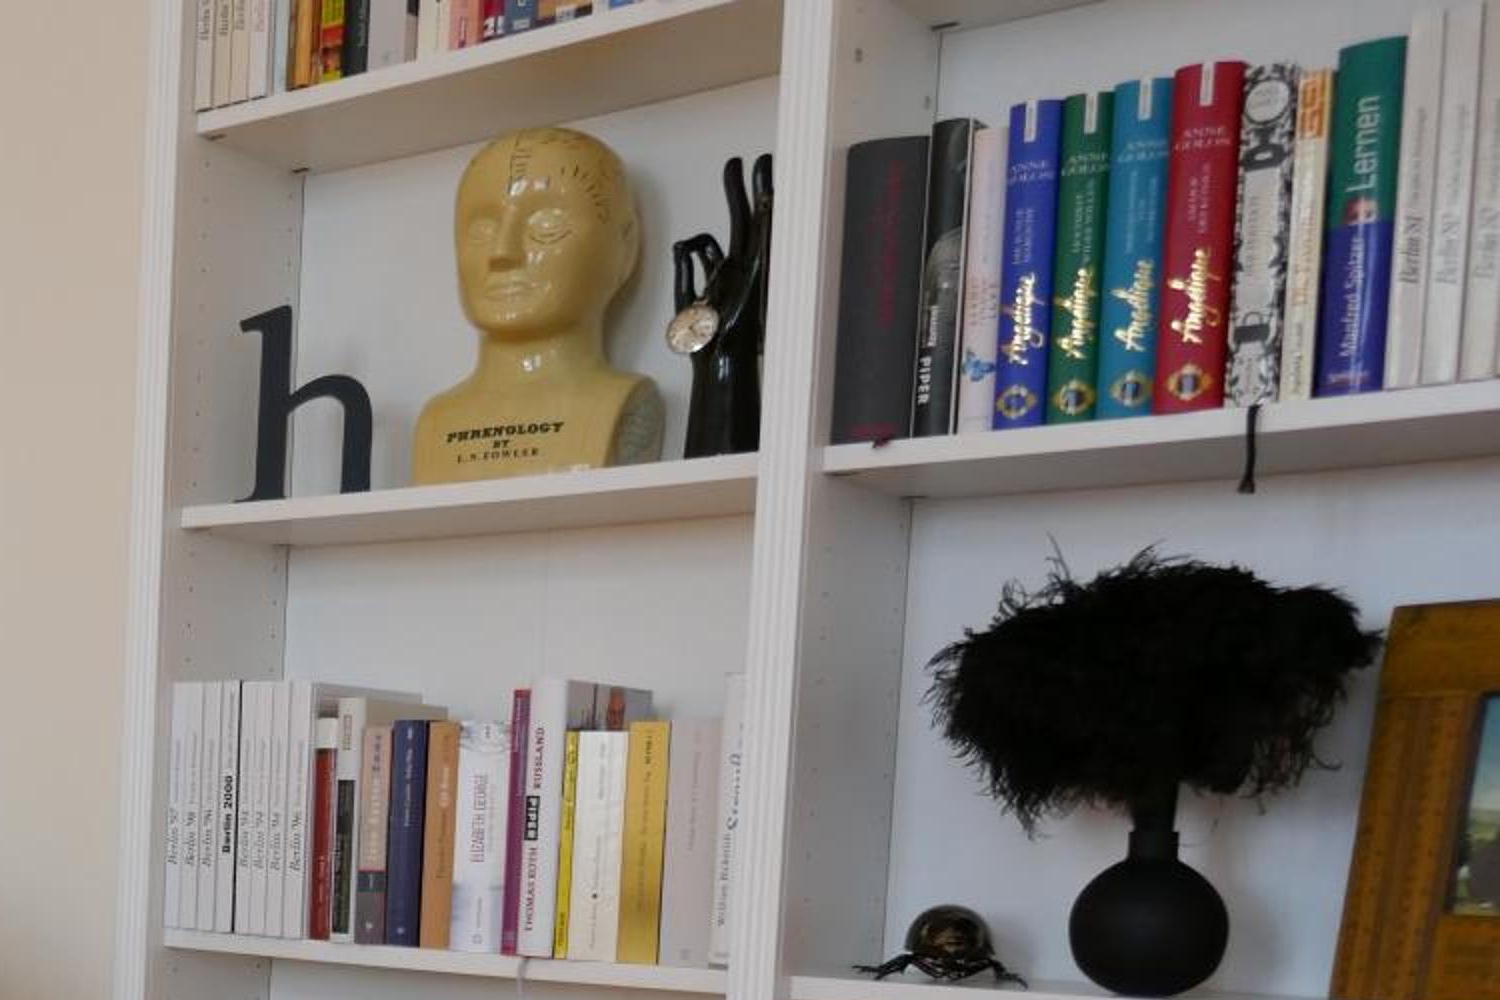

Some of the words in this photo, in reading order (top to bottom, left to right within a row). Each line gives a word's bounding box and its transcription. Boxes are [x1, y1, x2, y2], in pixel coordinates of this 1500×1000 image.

[1348, 95, 1383, 192] Lernen
[918, 356, 931, 403] PIPER
[446, 421, 565, 443] PHRENOLOGY
[493, 440, 510, 449] BY
[532, 727, 545, 789] RUSSLAND
[223, 775, 234, 809] 2000
[473, 773, 486, 810] GEORGE
[221, 813, 232, 853] Berlin
[526, 798, 538, 837] PIPER
[168, 827, 179, 864] Berlin
[184, 831, 196, 867] Berlin
[201, 829, 212, 868] Berlin
[238, 831, 249, 867] Berlin
[254, 831, 264, 869] Berlin
[270, 832, 281, 871] Berlin
[290, 833, 302, 872] Berlin
[470, 814, 486, 863] ELIZABETH
[527, 847, 537, 879] ROTH
[523, 882, 535, 931] THOMAS
